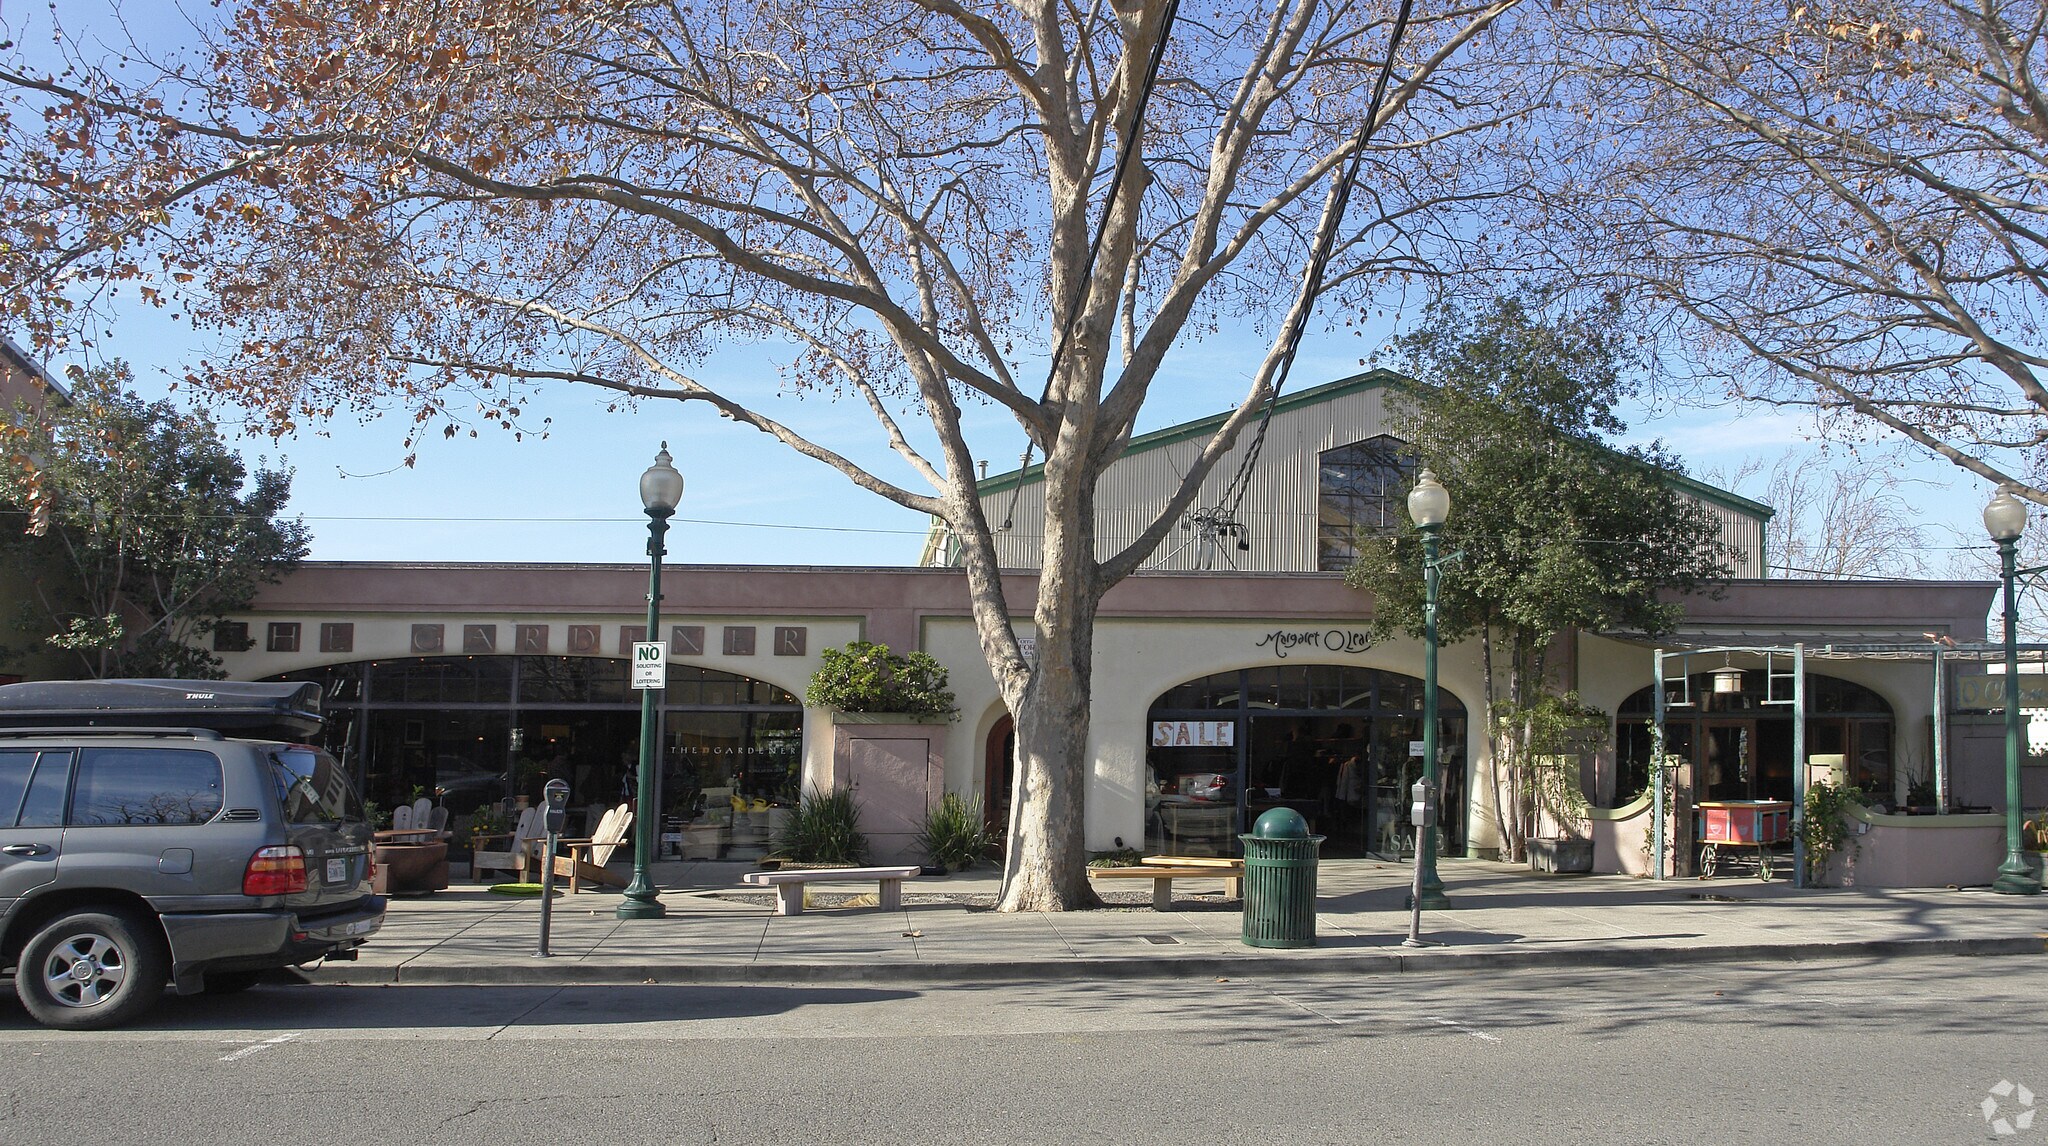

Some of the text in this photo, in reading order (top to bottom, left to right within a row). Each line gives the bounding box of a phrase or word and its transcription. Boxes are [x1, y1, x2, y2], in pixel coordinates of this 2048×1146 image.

[1256, 630, 1320, 658] Margaret
[638, 647, 660, 661] NO
[1153, 720, 1230, 746] SALE
[670, 746, 796, 755] THE GARDENER
[1390, 833, 1445, 851] SAE
